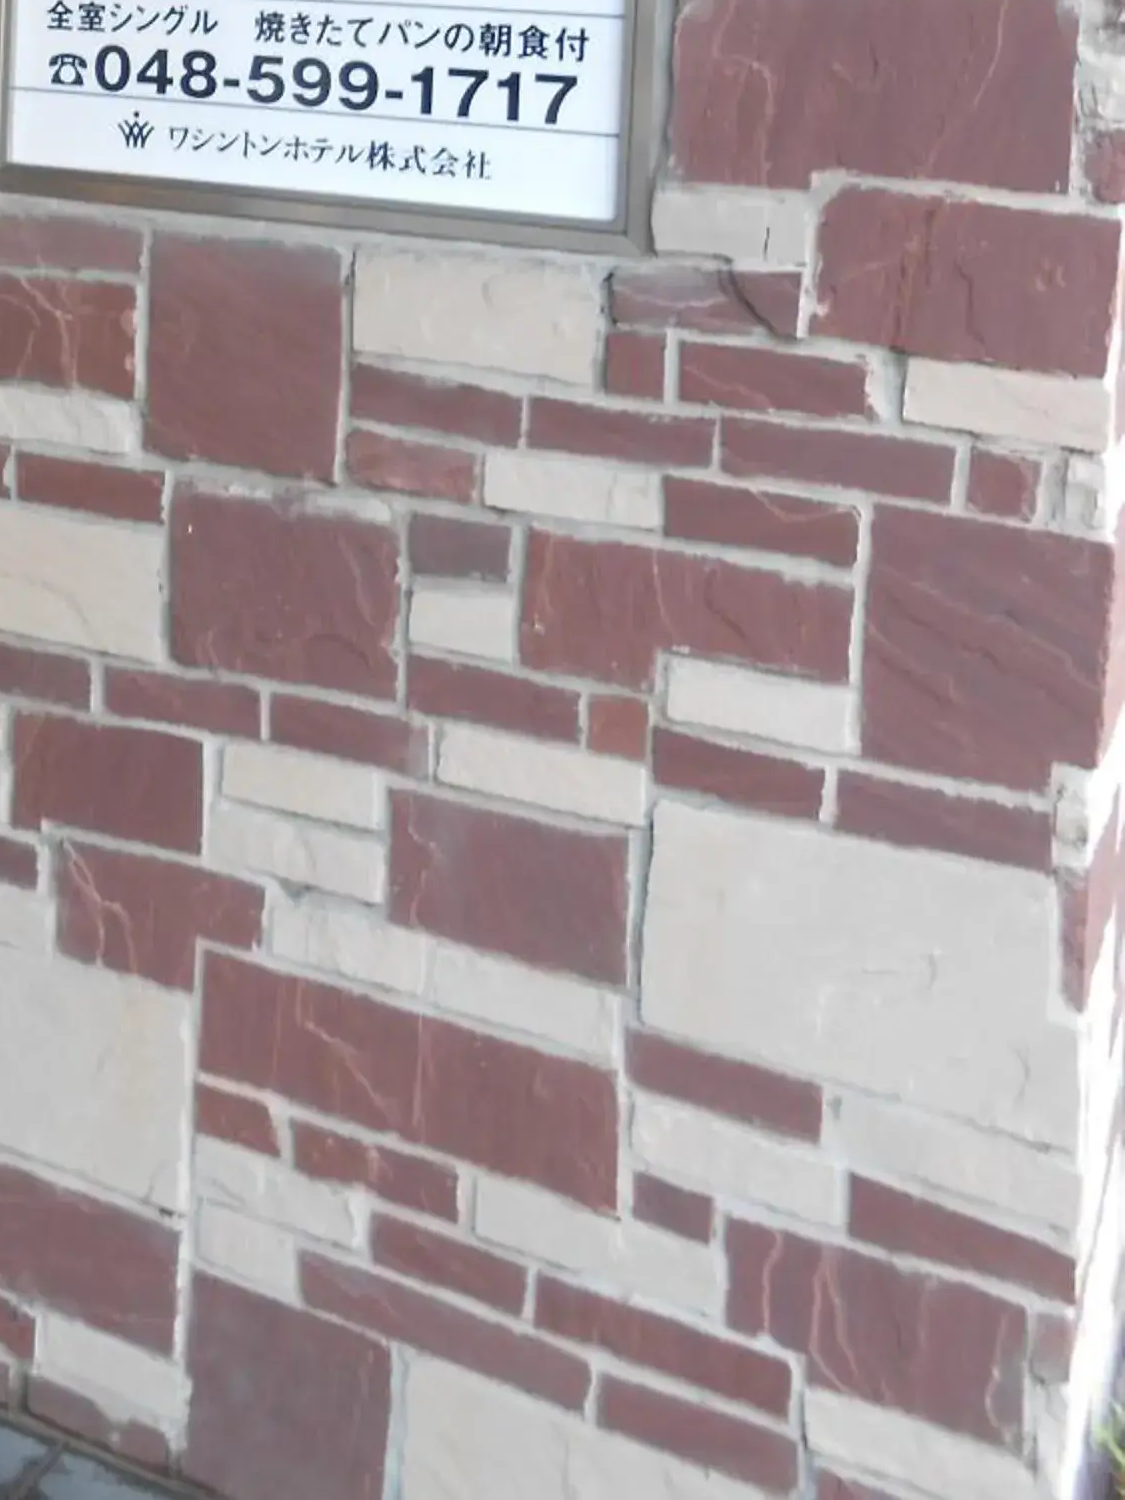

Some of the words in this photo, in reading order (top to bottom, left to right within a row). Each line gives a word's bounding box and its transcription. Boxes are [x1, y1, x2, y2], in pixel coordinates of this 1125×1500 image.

[47, 0, 219, 36] 全室シングル
[254, 10, 590, 62] 焼きたてパンの朝食付
[94, 44, 579, 126] 048-599-1717
[168, 126, 493, 181] ワシントンホテル株式会社
